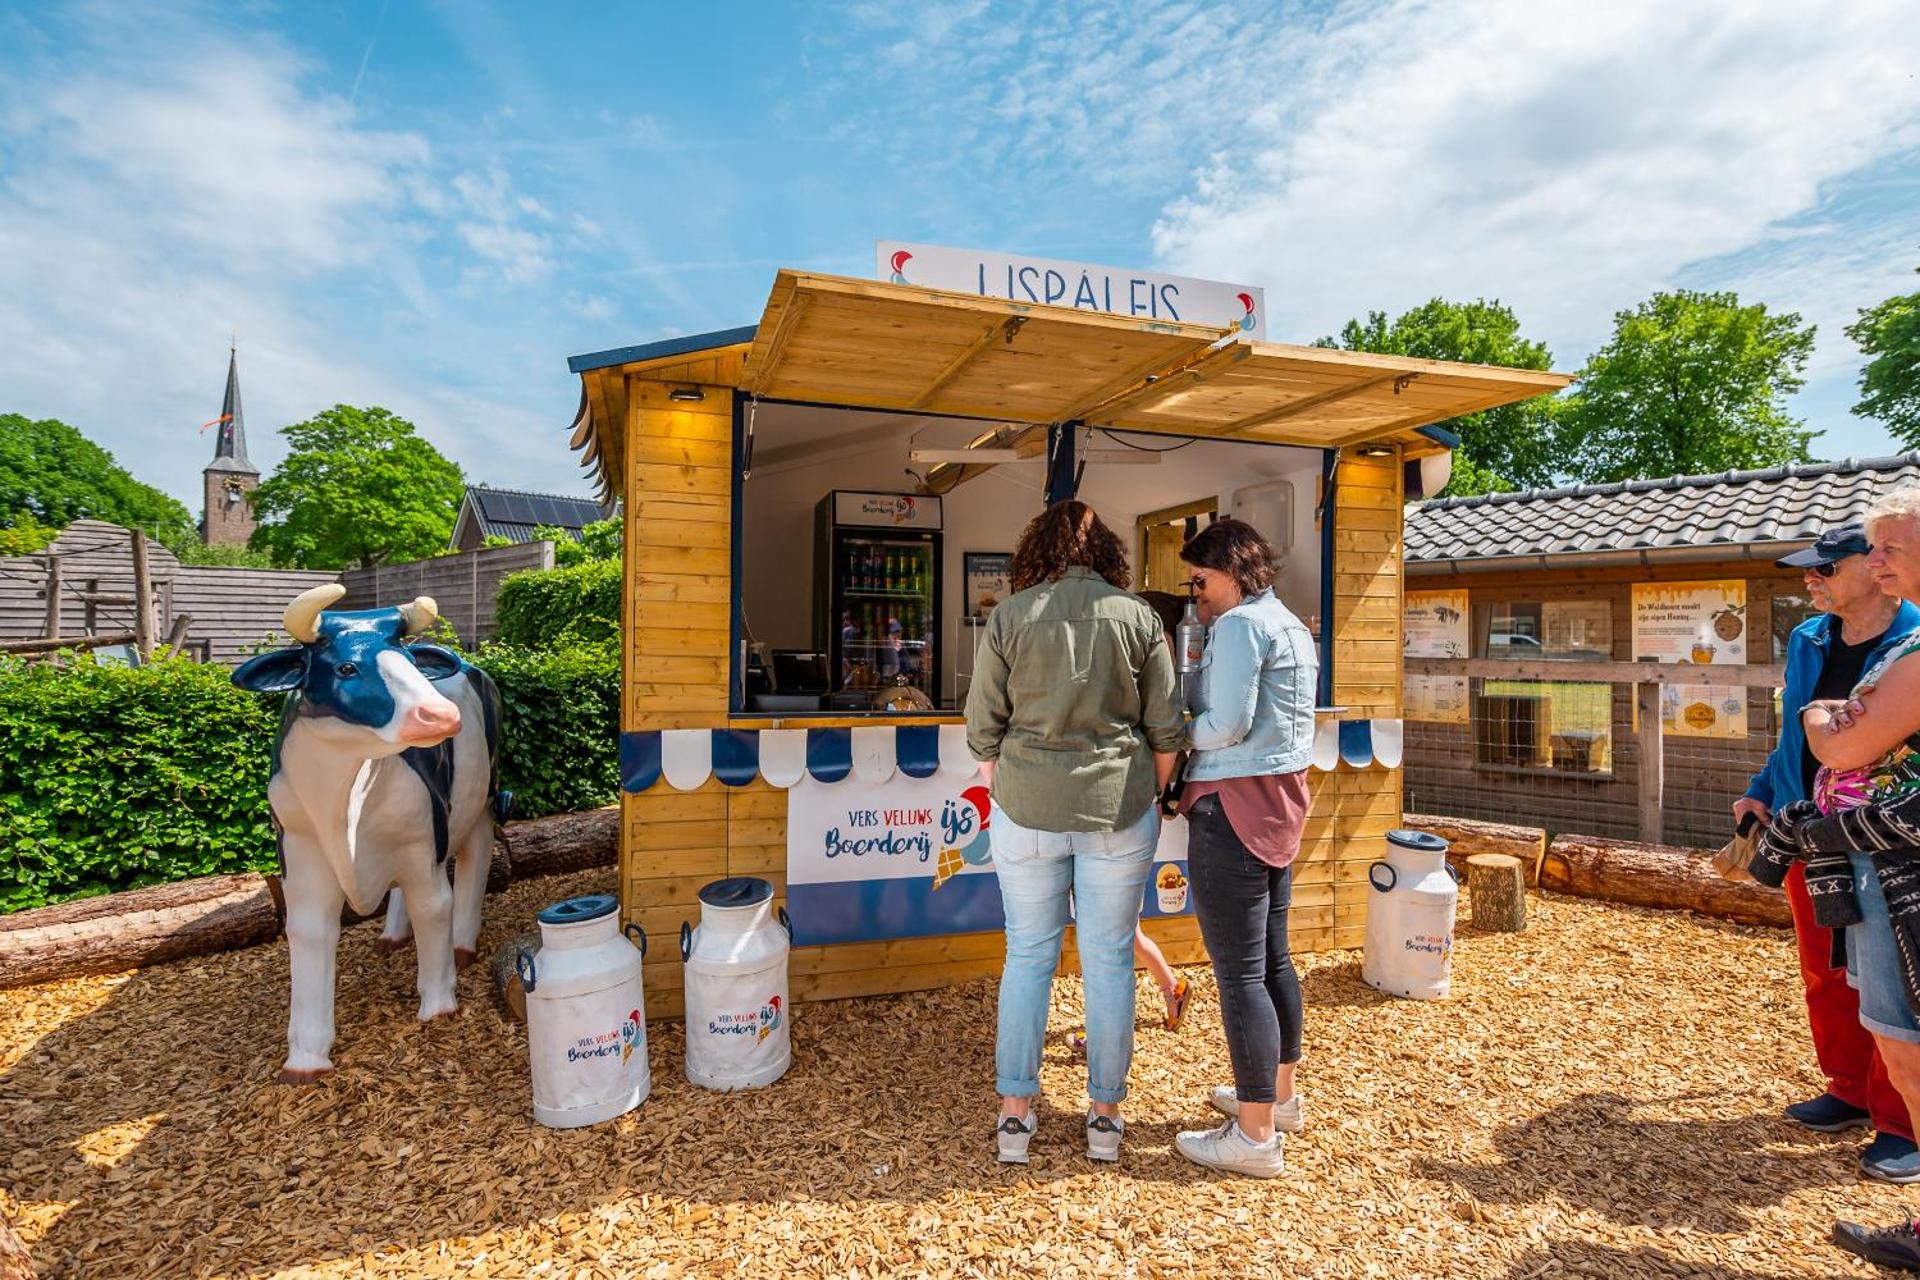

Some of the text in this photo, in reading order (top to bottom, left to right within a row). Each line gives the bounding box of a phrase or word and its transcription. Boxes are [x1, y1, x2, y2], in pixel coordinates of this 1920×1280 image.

[848, 808, 933, 827] VERS VELUWS
[825, 800, 977, 862] Boerderij ijs
[709, 1021, 756, 1036] Boerderij
[567, 1041, 621, 1062] Boerderij
